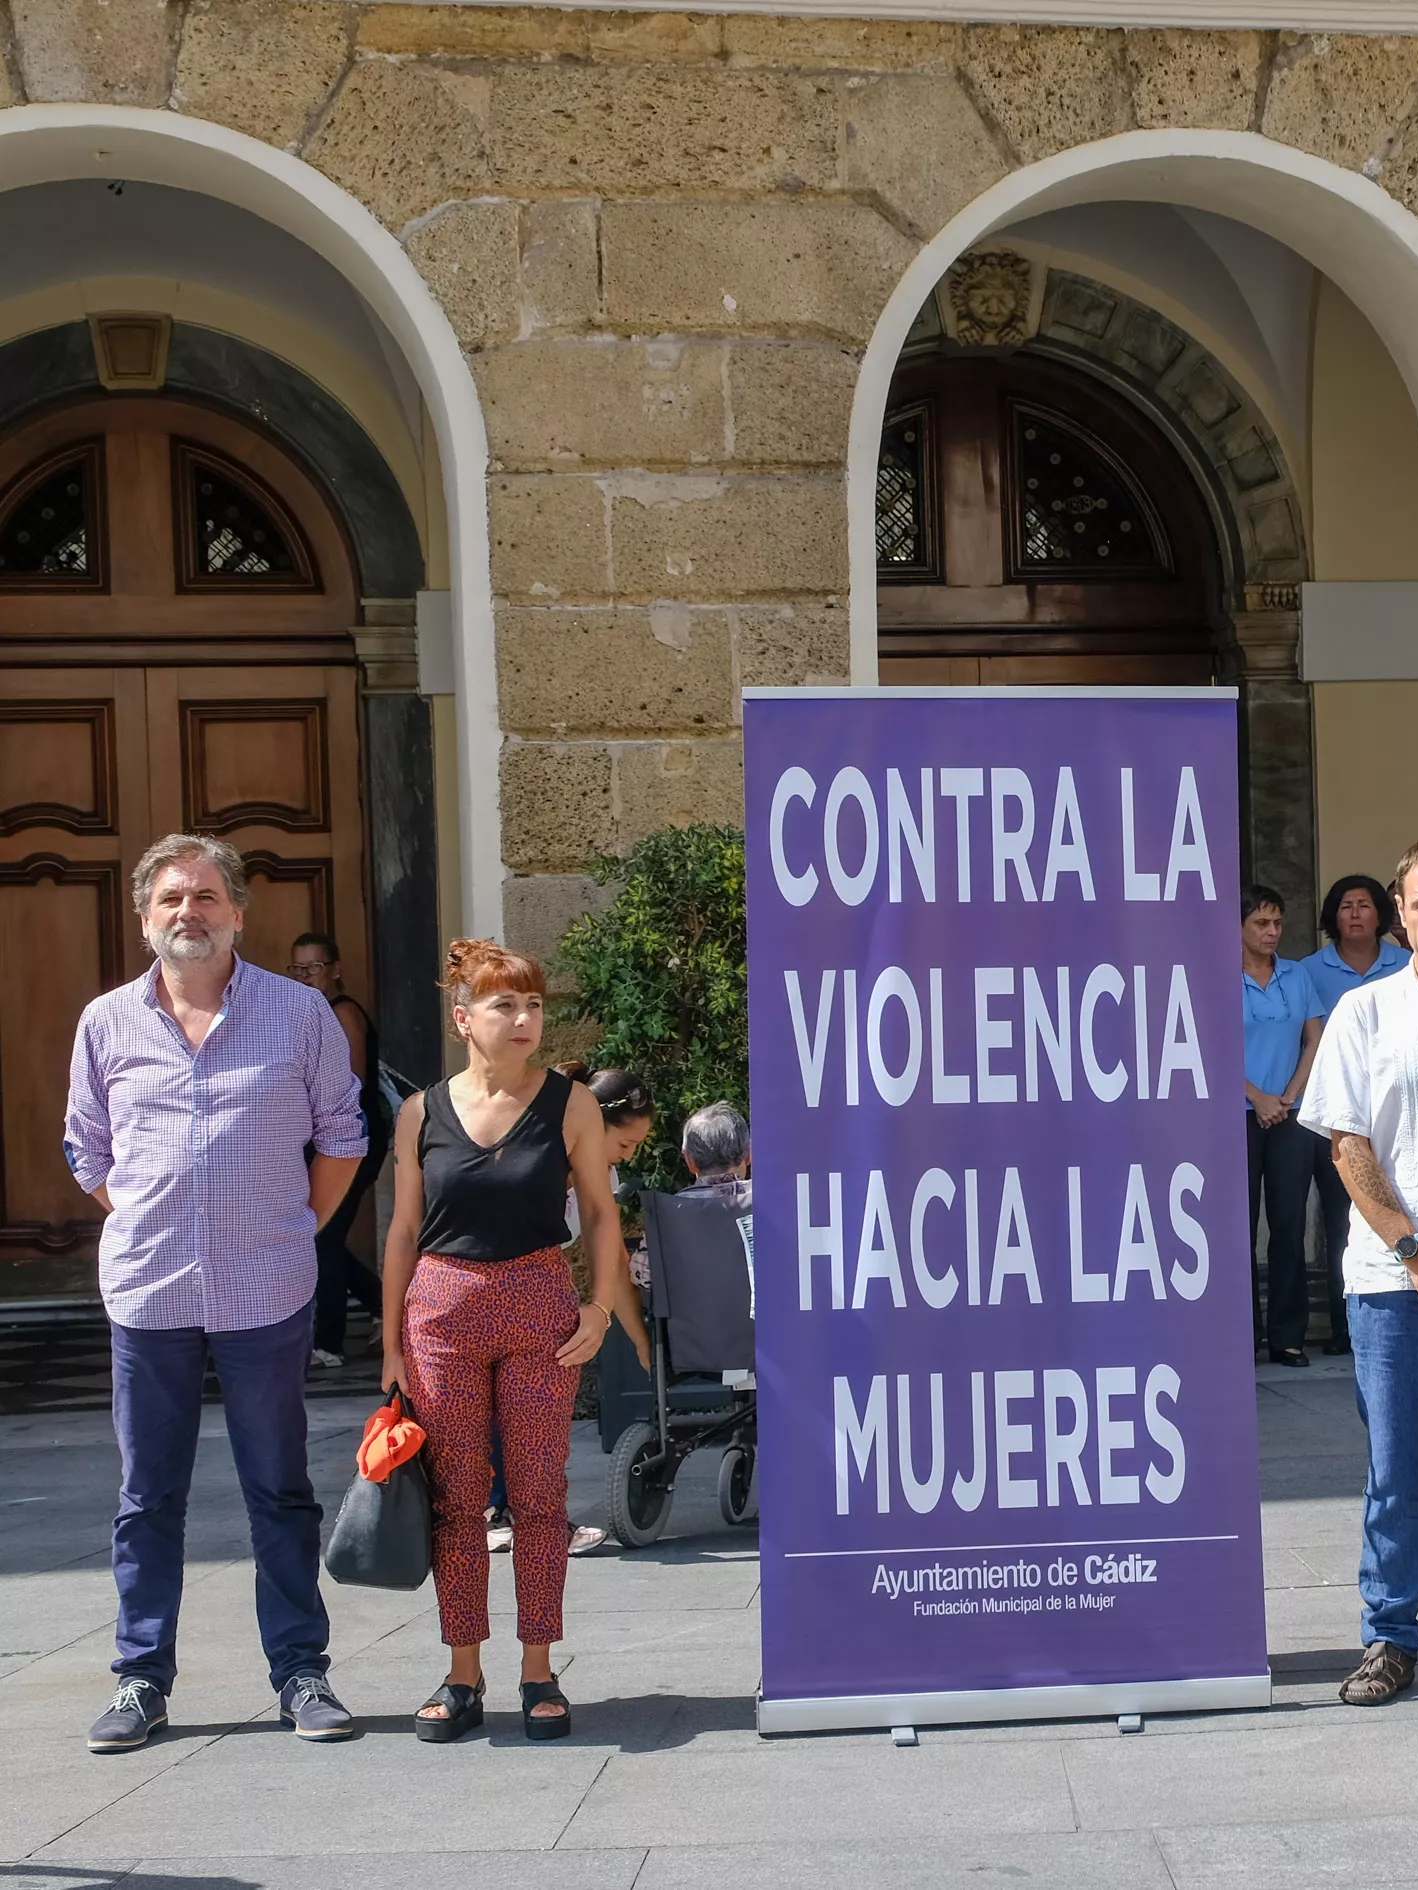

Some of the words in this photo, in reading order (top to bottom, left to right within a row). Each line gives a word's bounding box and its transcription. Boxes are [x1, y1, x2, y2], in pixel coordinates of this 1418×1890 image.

[769, 766, 1096, 907] CONTRA
[1120, 766, 1217, 902] LA
[783, 963, 1210, 1108] VIOLENCIA
[796, 1167, 1043, 1311] HACIA
[1068, 1162, 1210, 1303] LAS
[833, 1363, 1186, 1515] MUJERES
[871, 1559, 1042, 1600] Ayuntamiento
[1047, 1557, 1078, 1587] de
[1084, 1553, 1158, 1585] Cádiz
[913, 1598, 979, 1616] Fundación
[982, 1595, 1043, 1614] Municipal
[1046, 1594, 1062, 1610] de
[1065, 1594, 1077, 1610] la
[1079, 1592, 1116, 1612] Mujer
